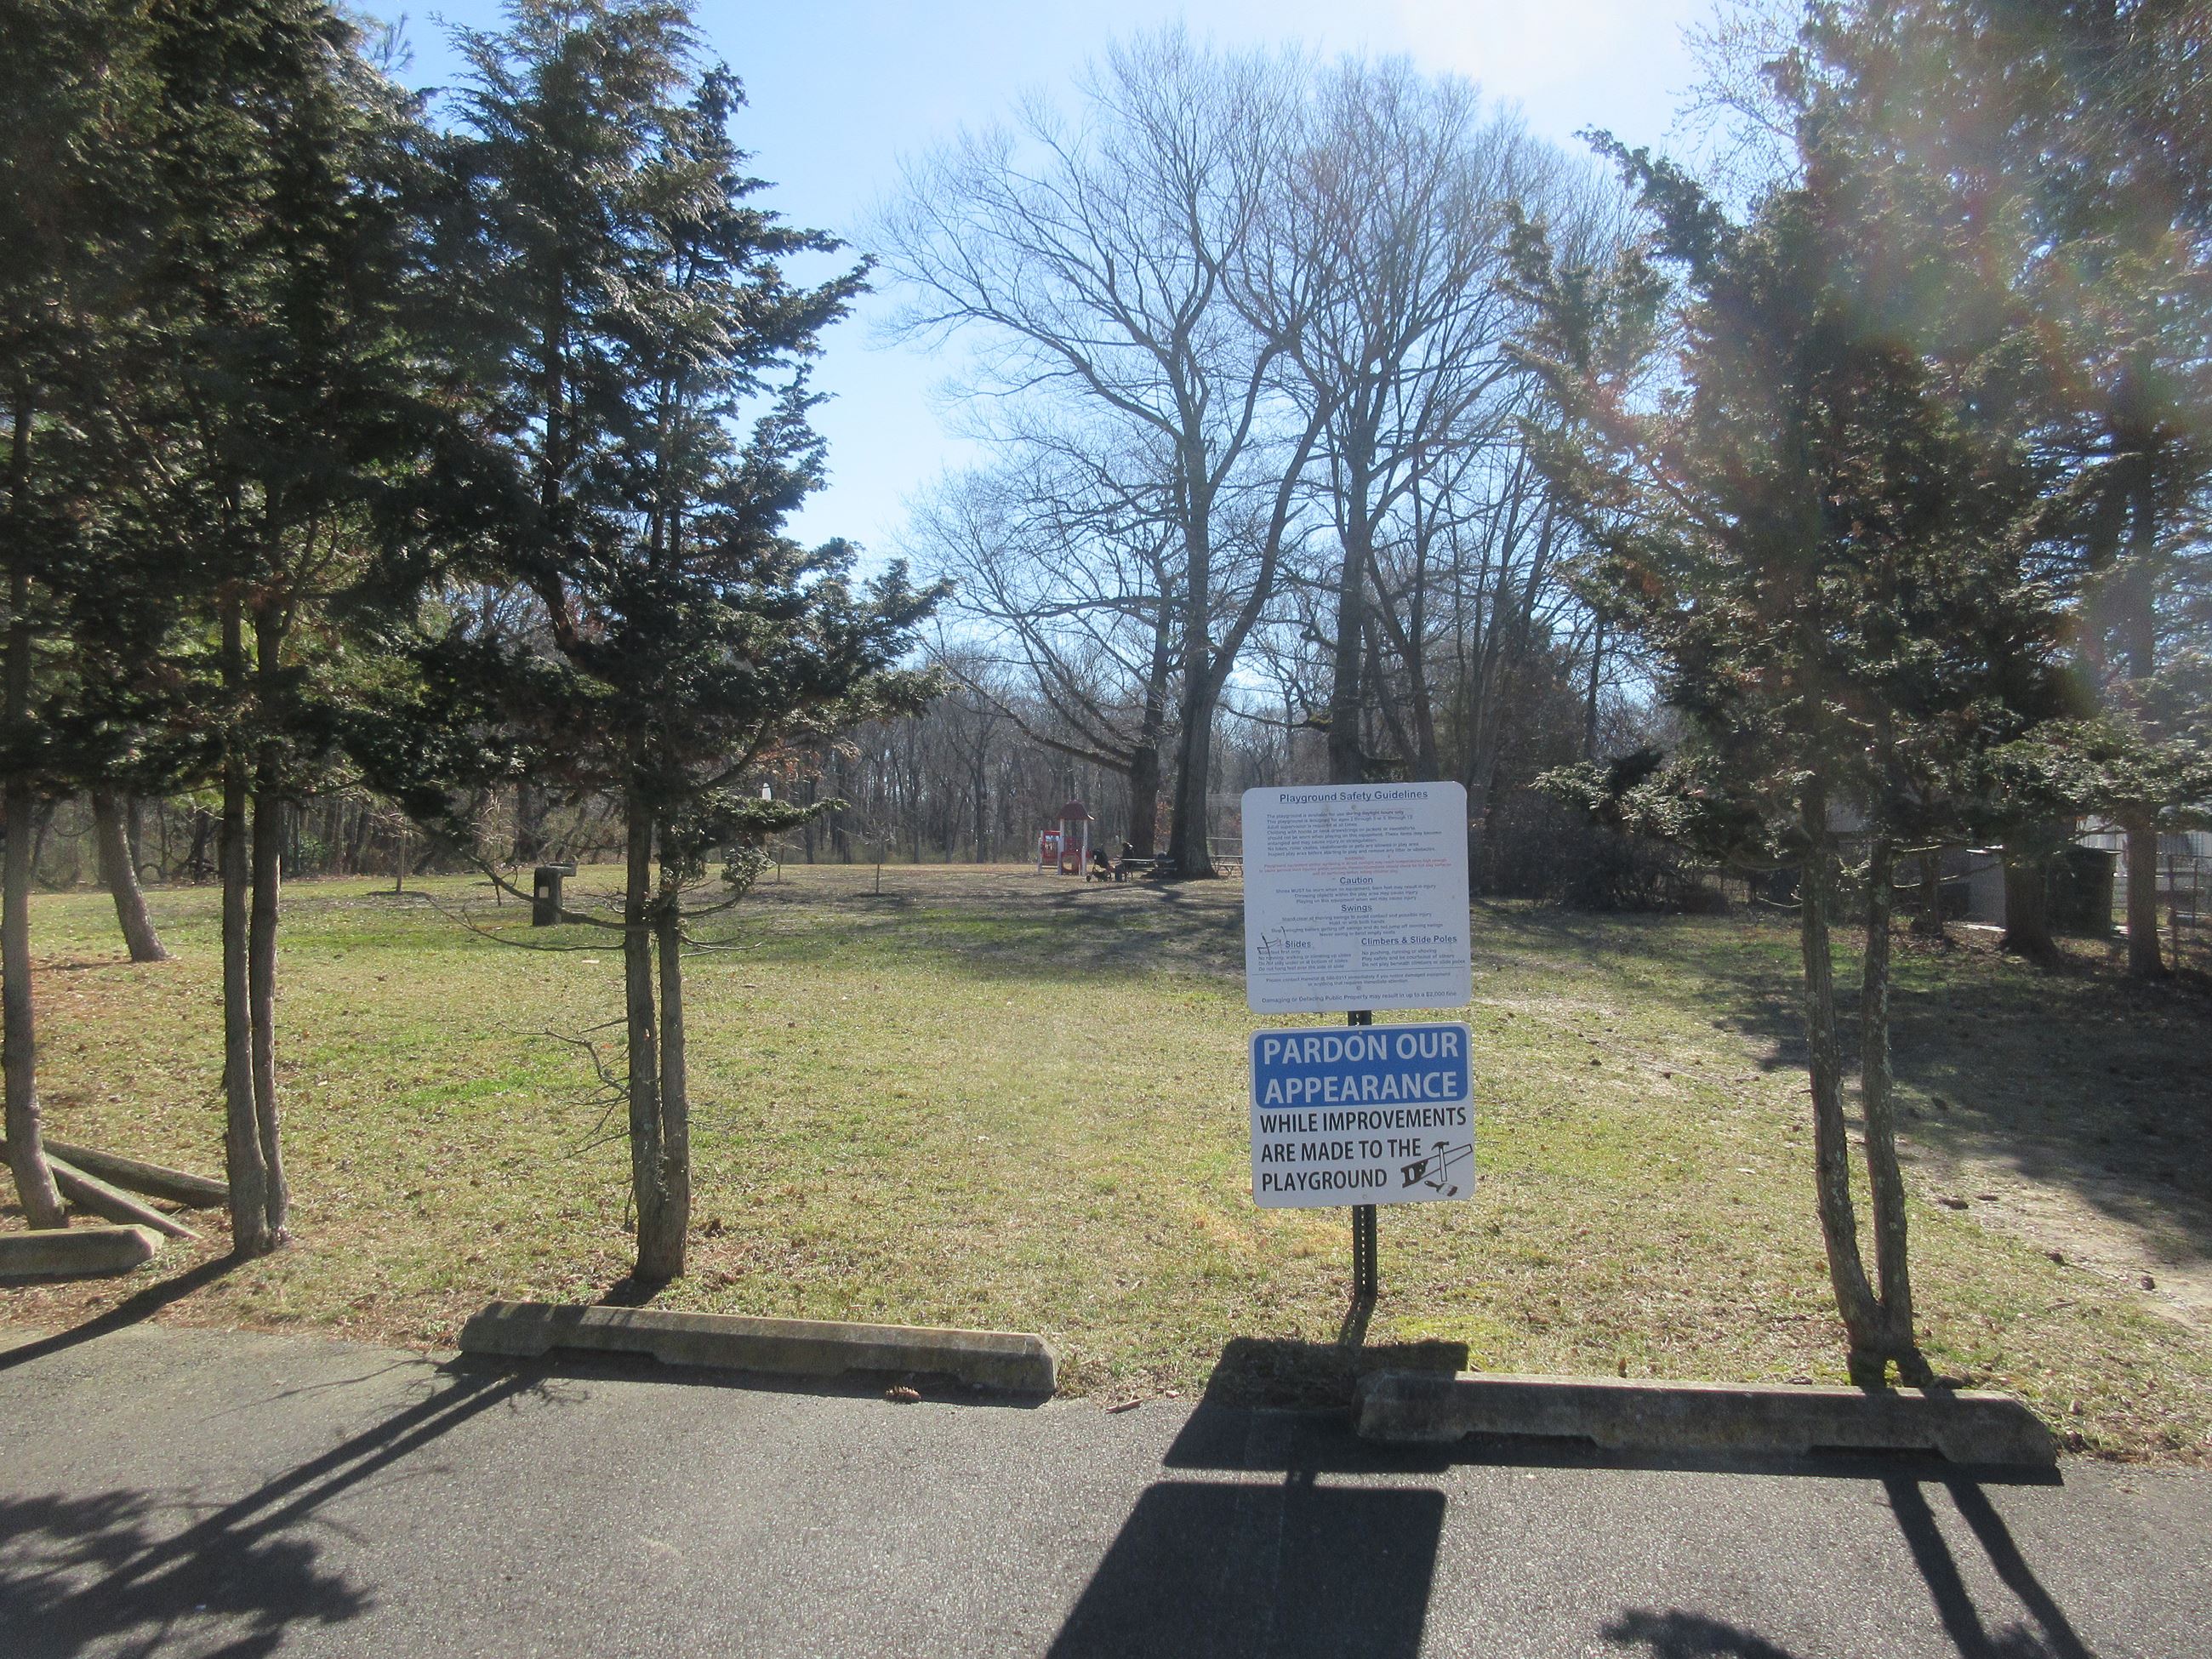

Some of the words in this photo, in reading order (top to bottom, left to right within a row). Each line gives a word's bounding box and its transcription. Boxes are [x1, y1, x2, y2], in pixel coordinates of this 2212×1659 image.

[1280, 793, 1337, 804] Playground
[1340, 792, 1371, 802] Safety
[1375, 790, 1428, 799] Guidelines
[1341, 904, 1372, 913] Swings
[1361, 937, 1399, 945] Climbers
[1434, 934, 1457, 943] Poles
[1264, 1035, 1387, 1064] PARDON
[1396, 1032, 1458, 1059] OUR
[1264, 1072, 1457, 1104] APPEARANCE
[1260, 1114, 1317, 1132] WHILE
[1324, 1107, 1466, 1131] IMPROVEMENTS
[1262, 1143, 1296, 1162] ARE
[1301, 1142, 1354, 1160] MADE
[1359, 1141, 1382, 1159] TO
[1388, 1138, 1421, 1158] THE
[1262, 1169, 1387, 1191] PLAYGROUND
